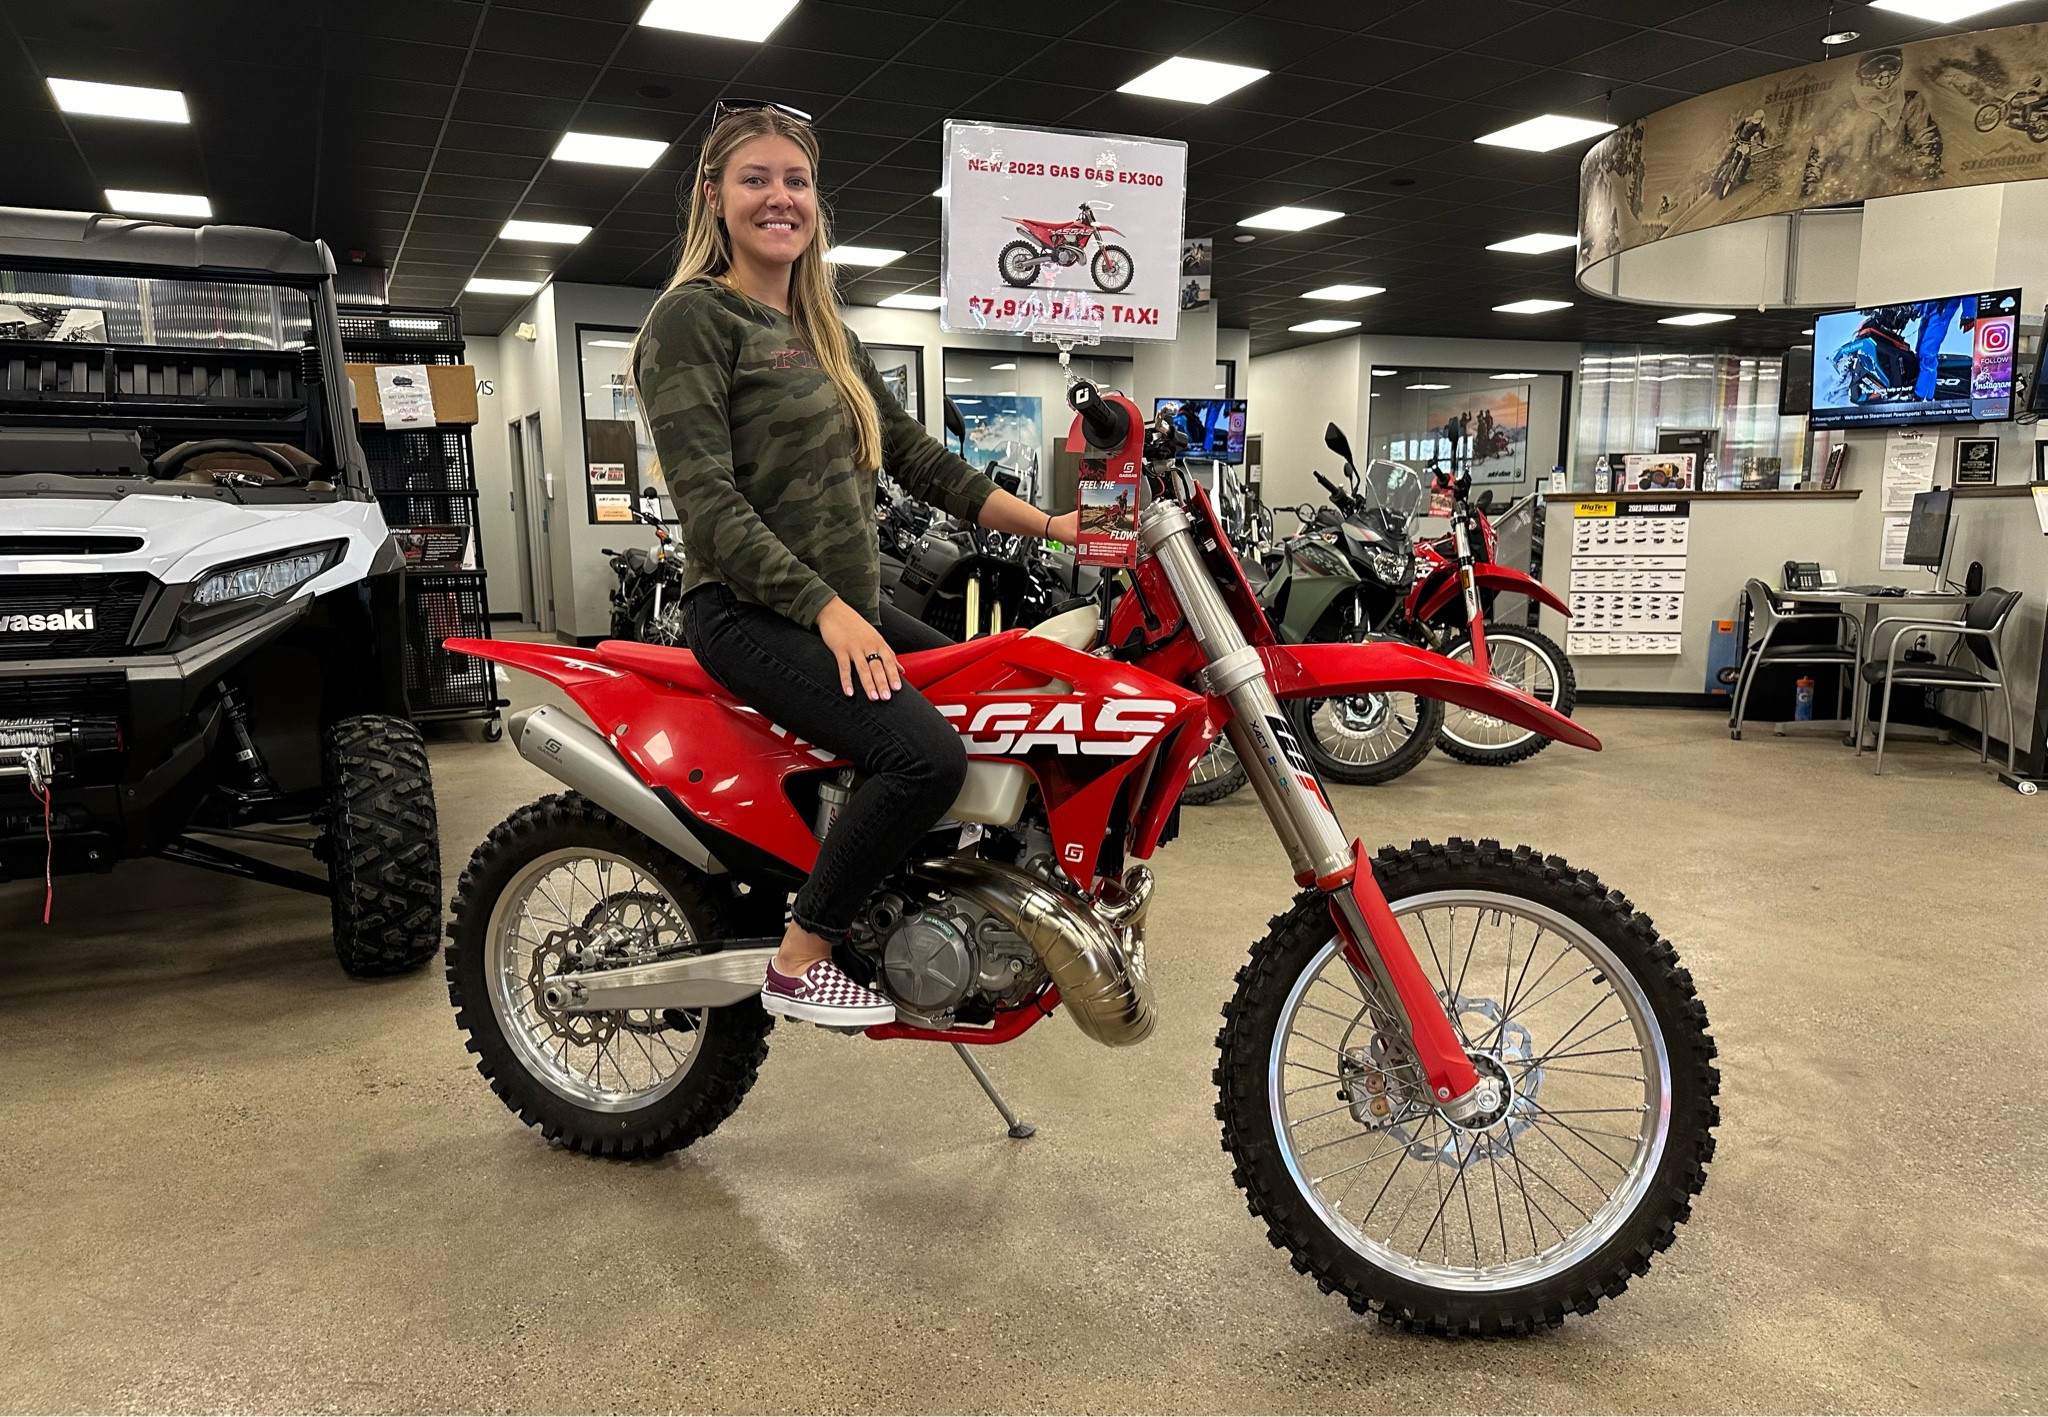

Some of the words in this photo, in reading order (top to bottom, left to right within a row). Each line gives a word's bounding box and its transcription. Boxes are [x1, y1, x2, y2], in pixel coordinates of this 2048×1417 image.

[1960, 152, 2046, 171] STEAMBOAT
[968, 159, 1002, 172] NEW
[1008, 162, 1044, 176] 2023
[1049, 165, 1080, 179] GAS
[1085, 168, 1114, 182] GAS
[1119, 172, 1163, 187] EX300
[1051, 302, 1105, 321] PLS
[1112, 305, 1158, 325] TAX!
[1981, 356, 2009, 365] FOLLOW
[1974, 381, 2012, 391] Instagram
[1893, 410, 1922, 418] Powersports!
[1078, 481, 1099, 490] FEEL
[1099, 481, 1116, 490] THE
[1580, 504, 1608, 512] BigTex
[1628, 504, 1642, 512] 2023
[1642, 504, 1659, 512] MODEL
[1659, 504, 1677, 512] CHART
[1109, 530, 1138, 541] FLOW!
[1249, 719, 1270, 750] XACT
